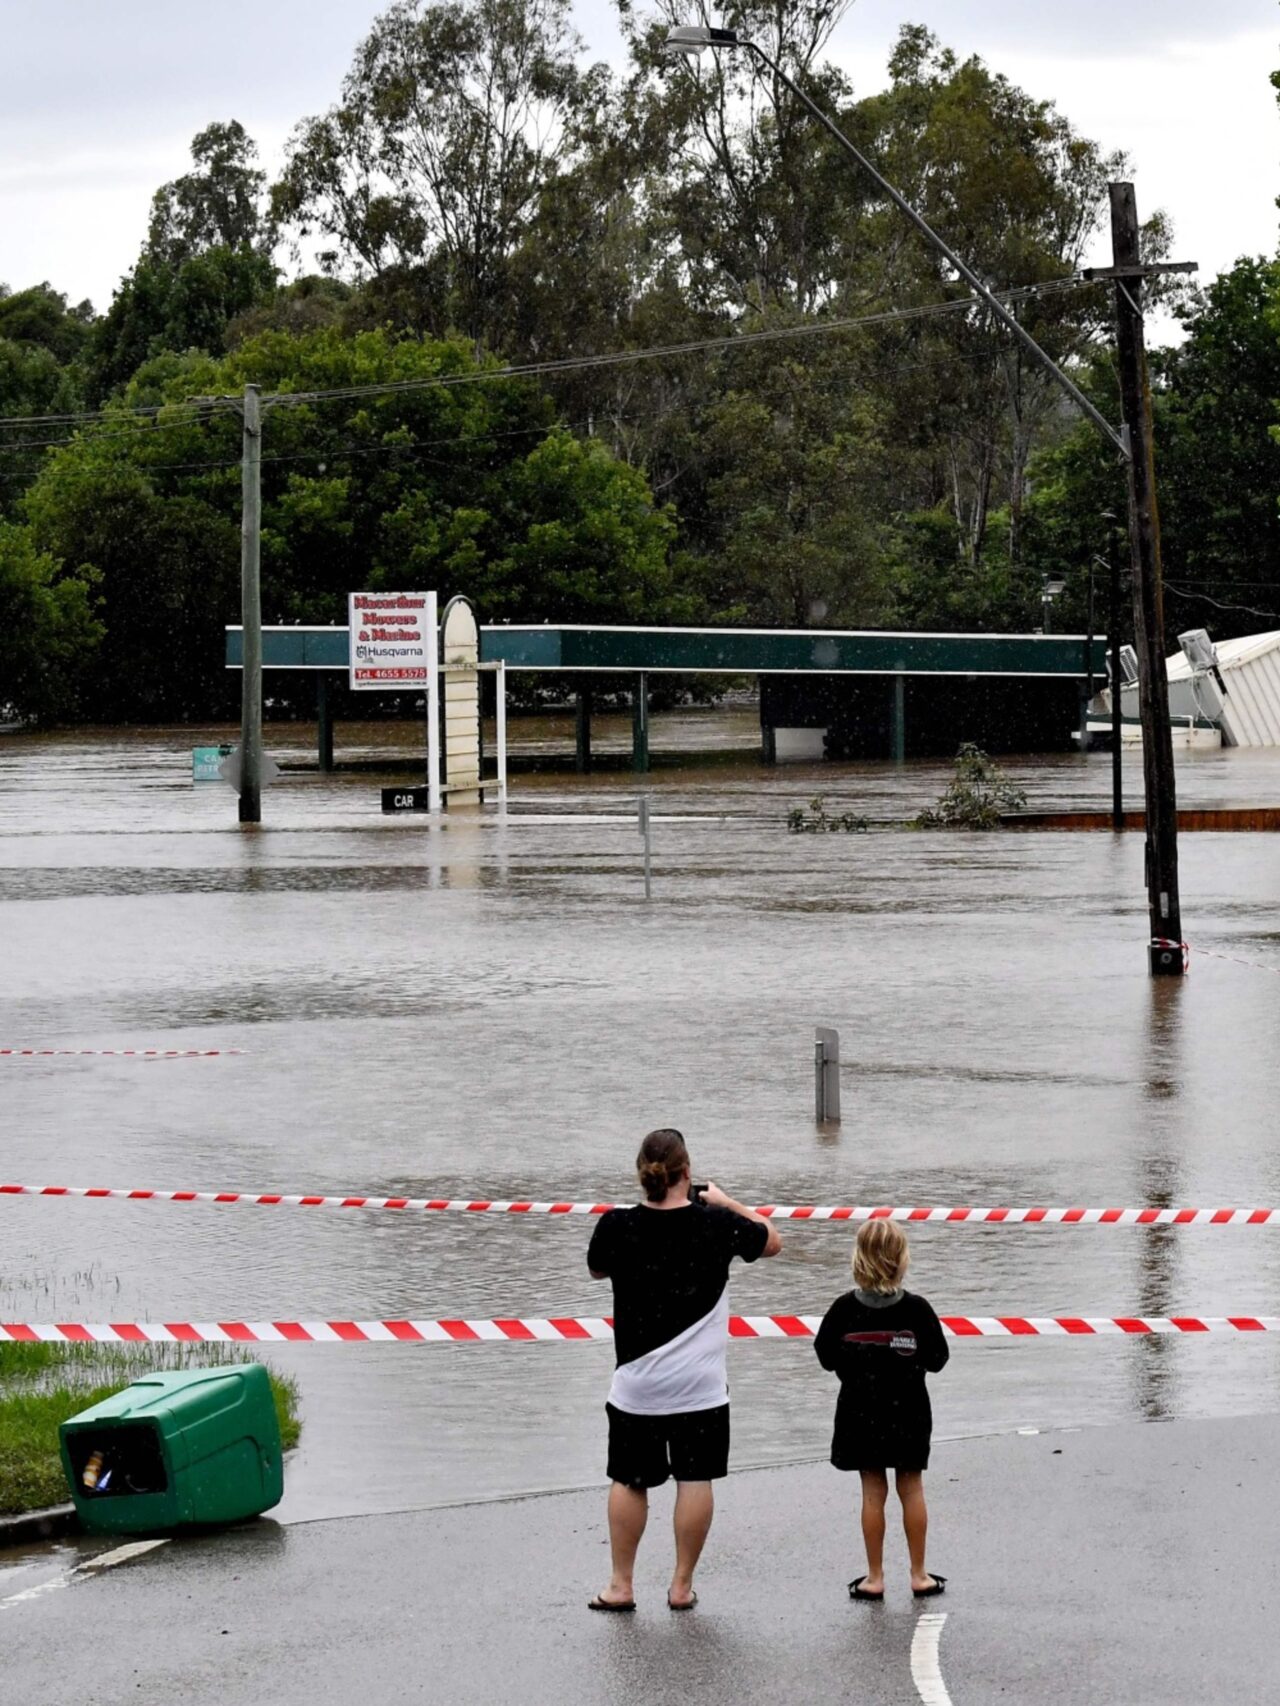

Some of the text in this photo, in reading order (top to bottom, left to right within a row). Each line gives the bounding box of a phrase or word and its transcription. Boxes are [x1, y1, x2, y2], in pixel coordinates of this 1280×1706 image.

[362, 612, 417, 625] Mowers
[358, 628, 421, 641] & Marine
[368, 647, 423, 658] Husqvarna
[394, 794, 414, 808] CAR
